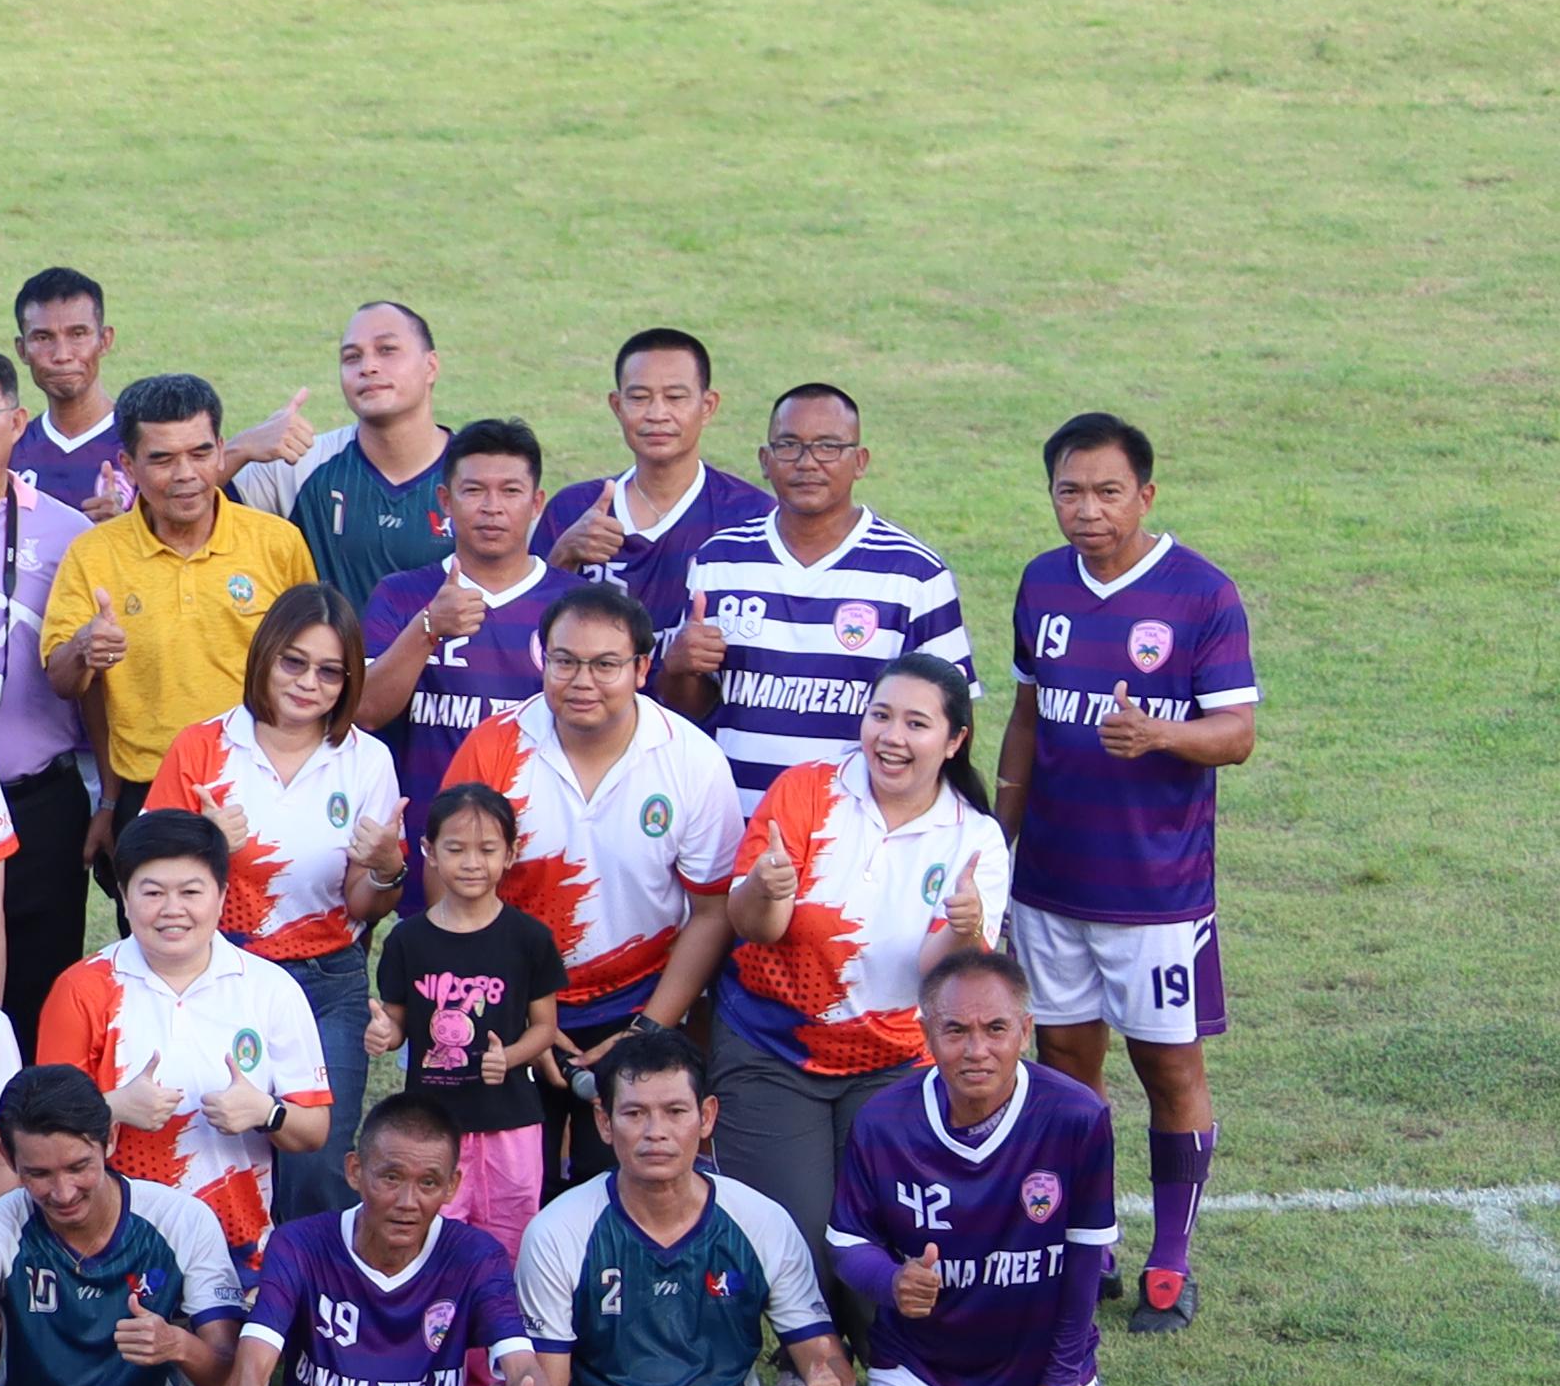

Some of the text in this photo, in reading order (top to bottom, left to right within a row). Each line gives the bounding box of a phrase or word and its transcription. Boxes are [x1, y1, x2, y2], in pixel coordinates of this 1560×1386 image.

[718, 594, 767, 639] 88
[1036, 613, 1072, 660] 19
[410, 692, 482, 729] ANANA
[1151, 963, 1190, 1009] 19
[896, 1181, 953, 1231] 42
[983, 1248, 1042, 1287] TREE
[601, 1268, 622, 1316] 2
